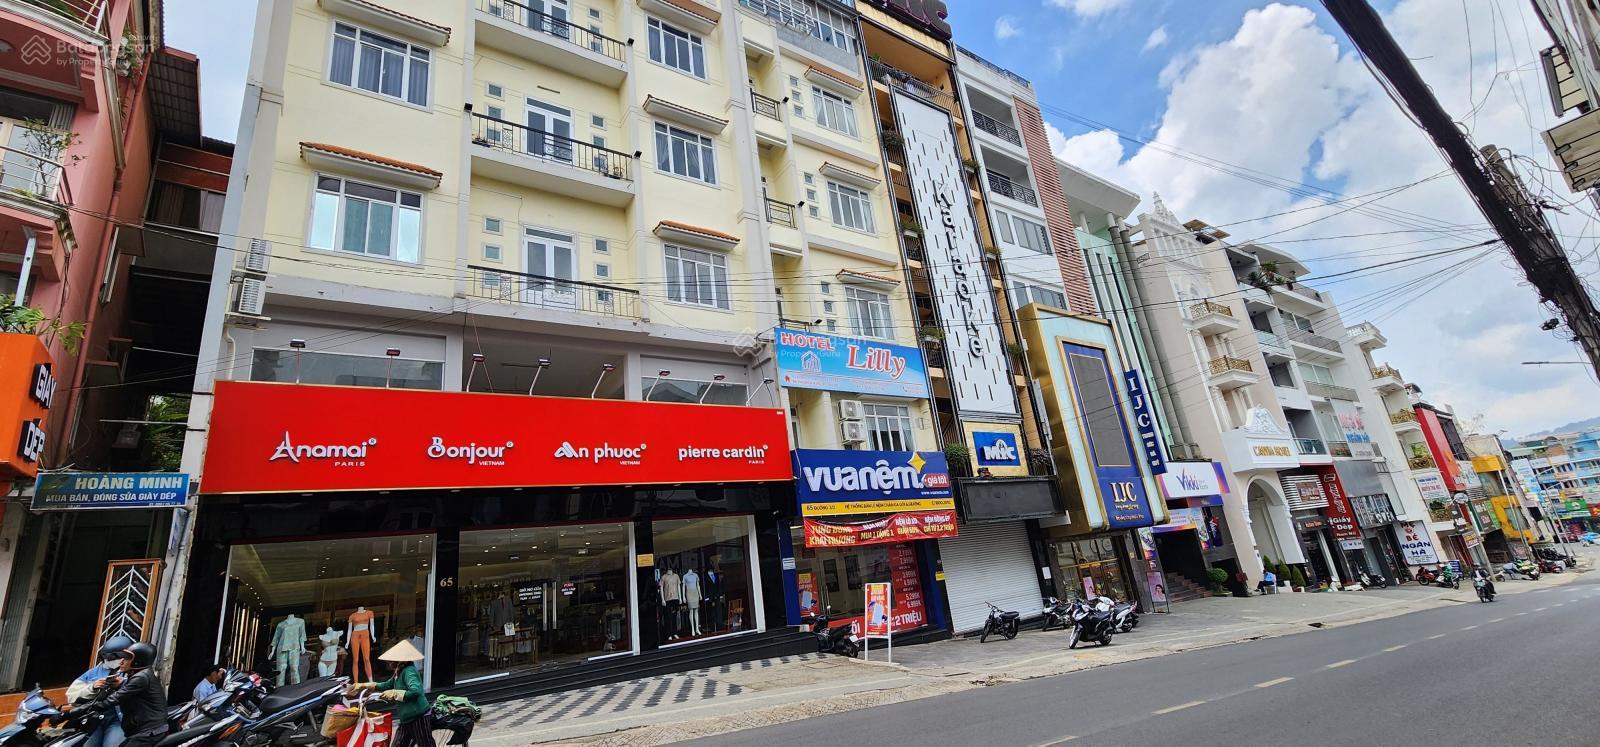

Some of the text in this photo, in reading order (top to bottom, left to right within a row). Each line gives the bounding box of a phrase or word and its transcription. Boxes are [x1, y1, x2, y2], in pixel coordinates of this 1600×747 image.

[932, 179, 983, 357] Karaoke
[781, 331, 835, 351] HOTEL
[847, 345, 906, 379] Lilly
[1127, 377, 1150, 428] IJC
[269, 431, 367, 462] Anamai
[427, 436, 506, 464] Bonjour
[594, 442, 641, 463] phuoc
[678, 444, 765, 461] pierre cardin
[75, 475, 183, 490] HOÀNG MINH
[1110, 482, 1137, 502] IJC
[160, 491, 176, 500] DÉP
[440, 577, 453, 587] 65
[901, 610, 922, 625] TRIỆU
